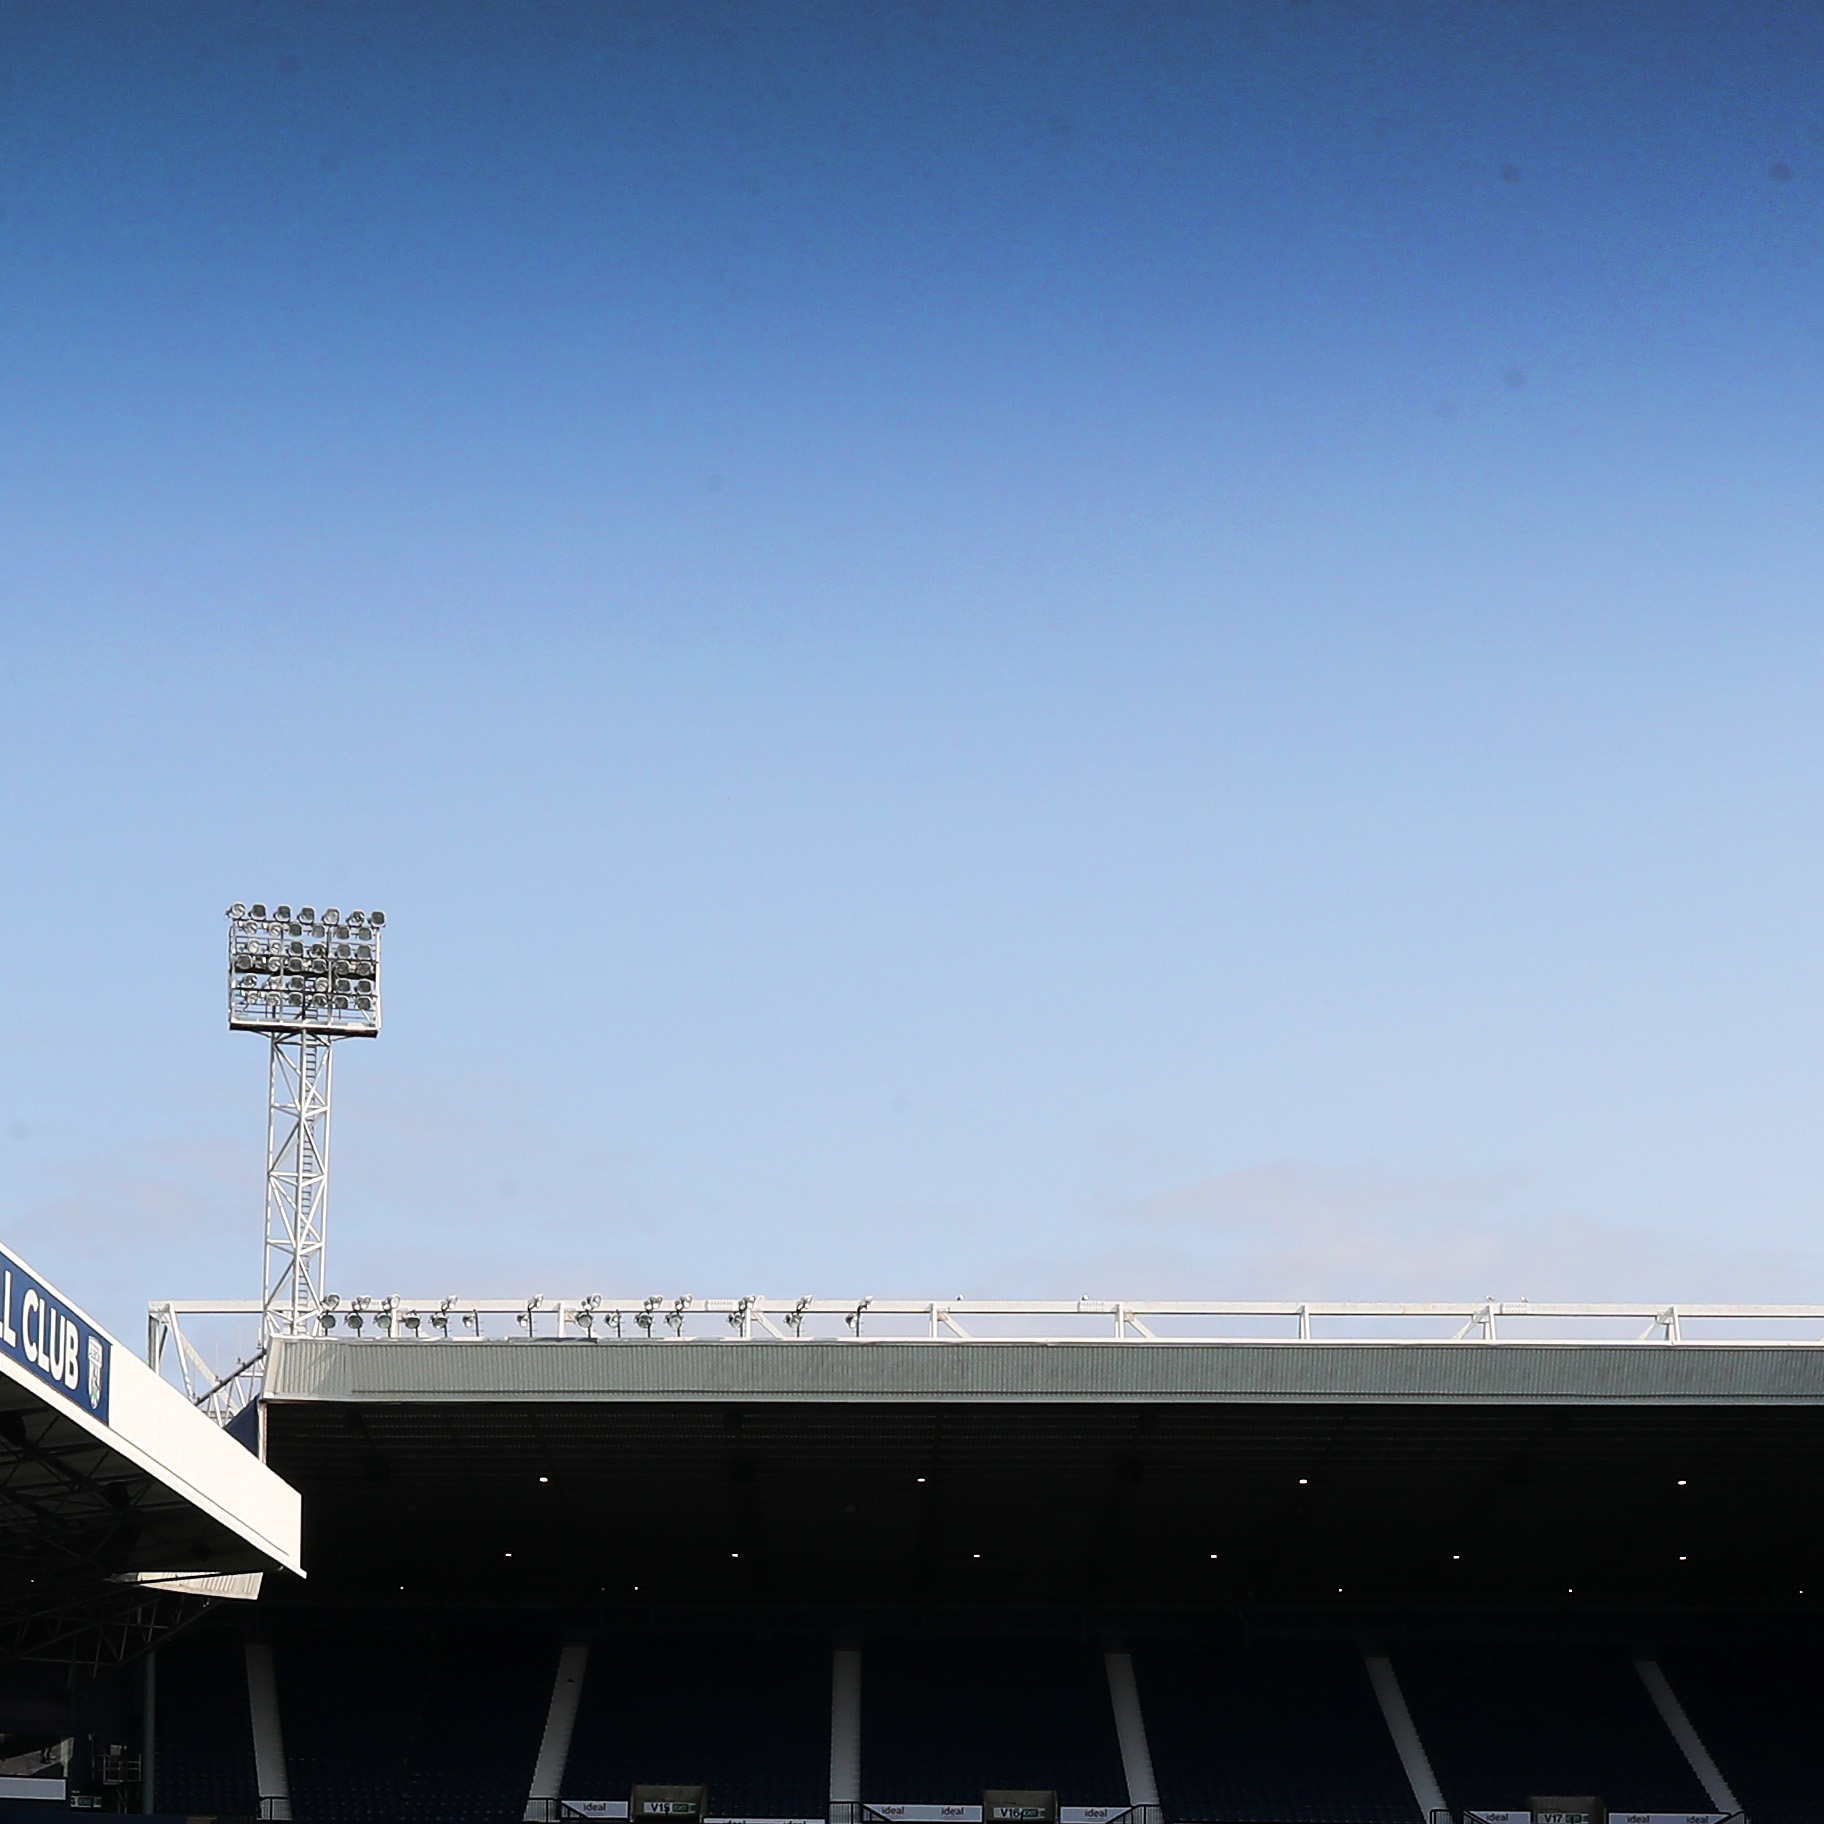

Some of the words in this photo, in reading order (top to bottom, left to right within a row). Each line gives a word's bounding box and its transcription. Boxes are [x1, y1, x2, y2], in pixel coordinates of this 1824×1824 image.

[22, 1288, 80, 1391] CLUB
[583, 1803, 607, 1812] ideal
[651, 1803, 670, 1812] V15
[882, 1807, 905, 1816] ideal
[941, 1807, 964, 1816] ideal
[1001, 1808, 1019, 1818] V16
[1085, 1809, 1108, 1818] ideal
[1486, 1813, 1509, 1822] ideal
[1545, 1814, 1563, 1823] V17
[1627, 1815, 1650, 1824] ideal
[1686, 1816, 1709, 1824] ideal
